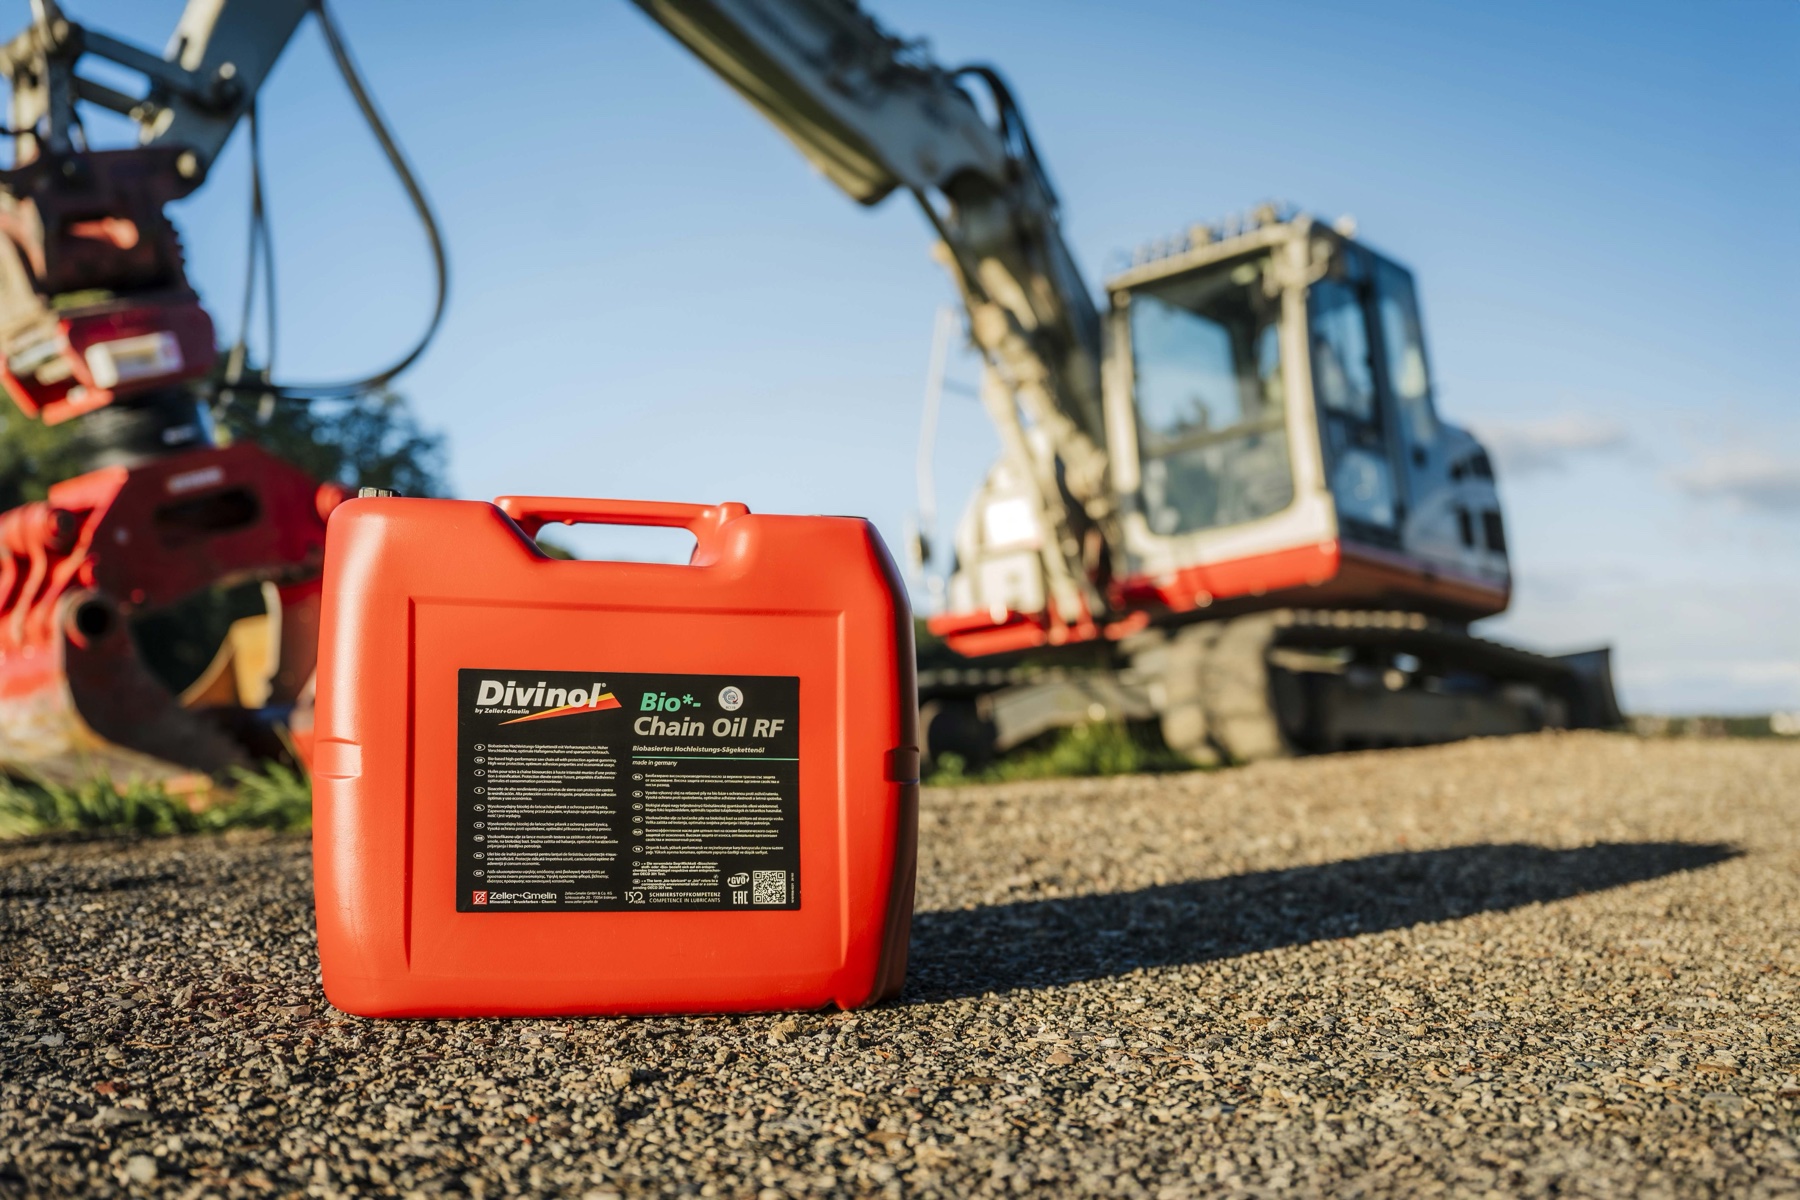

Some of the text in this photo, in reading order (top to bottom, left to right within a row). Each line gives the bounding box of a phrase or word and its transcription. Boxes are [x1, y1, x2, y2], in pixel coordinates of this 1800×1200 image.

[634, 716, 784, 738] Chain Oil RF
